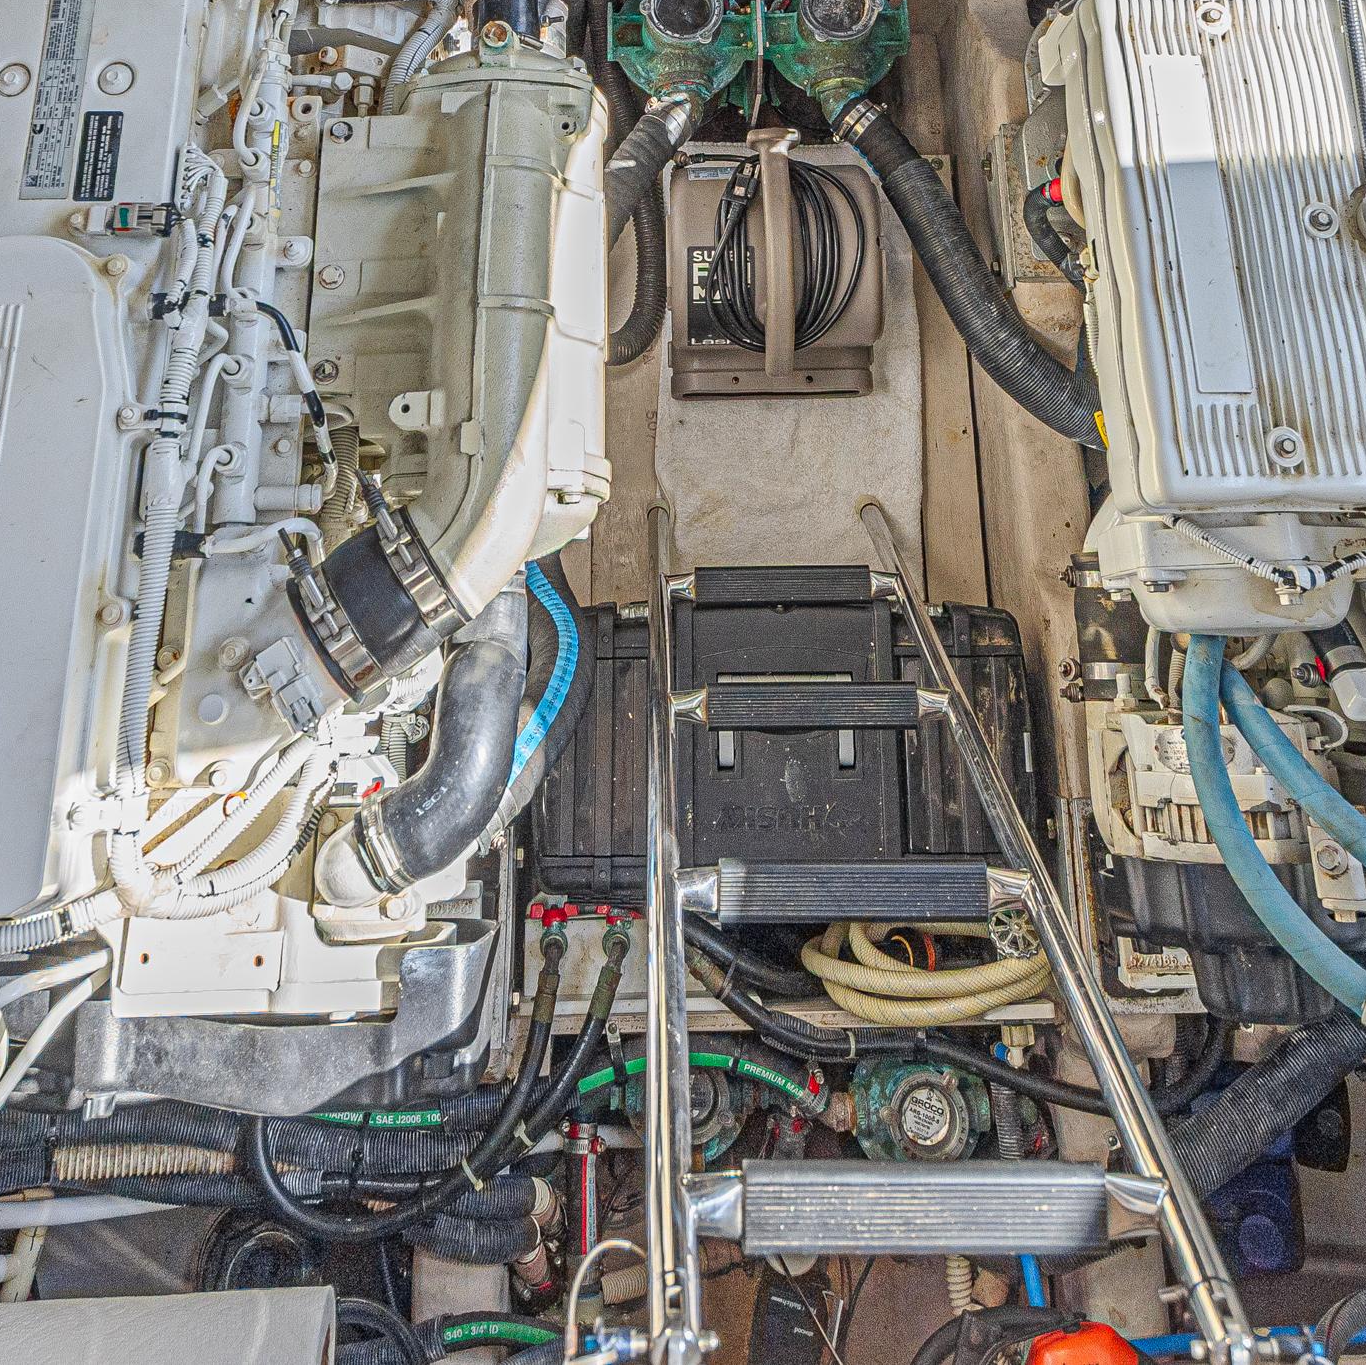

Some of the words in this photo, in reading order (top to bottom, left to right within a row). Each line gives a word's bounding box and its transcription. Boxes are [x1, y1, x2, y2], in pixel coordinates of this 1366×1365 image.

[744, 1063, 785, 1086] PREMIUM
[911, 1096, 944, 1115] GROCO
[376, 1115, 394, 1124] SAE
[396, 1114, 421, 1124] J2006
